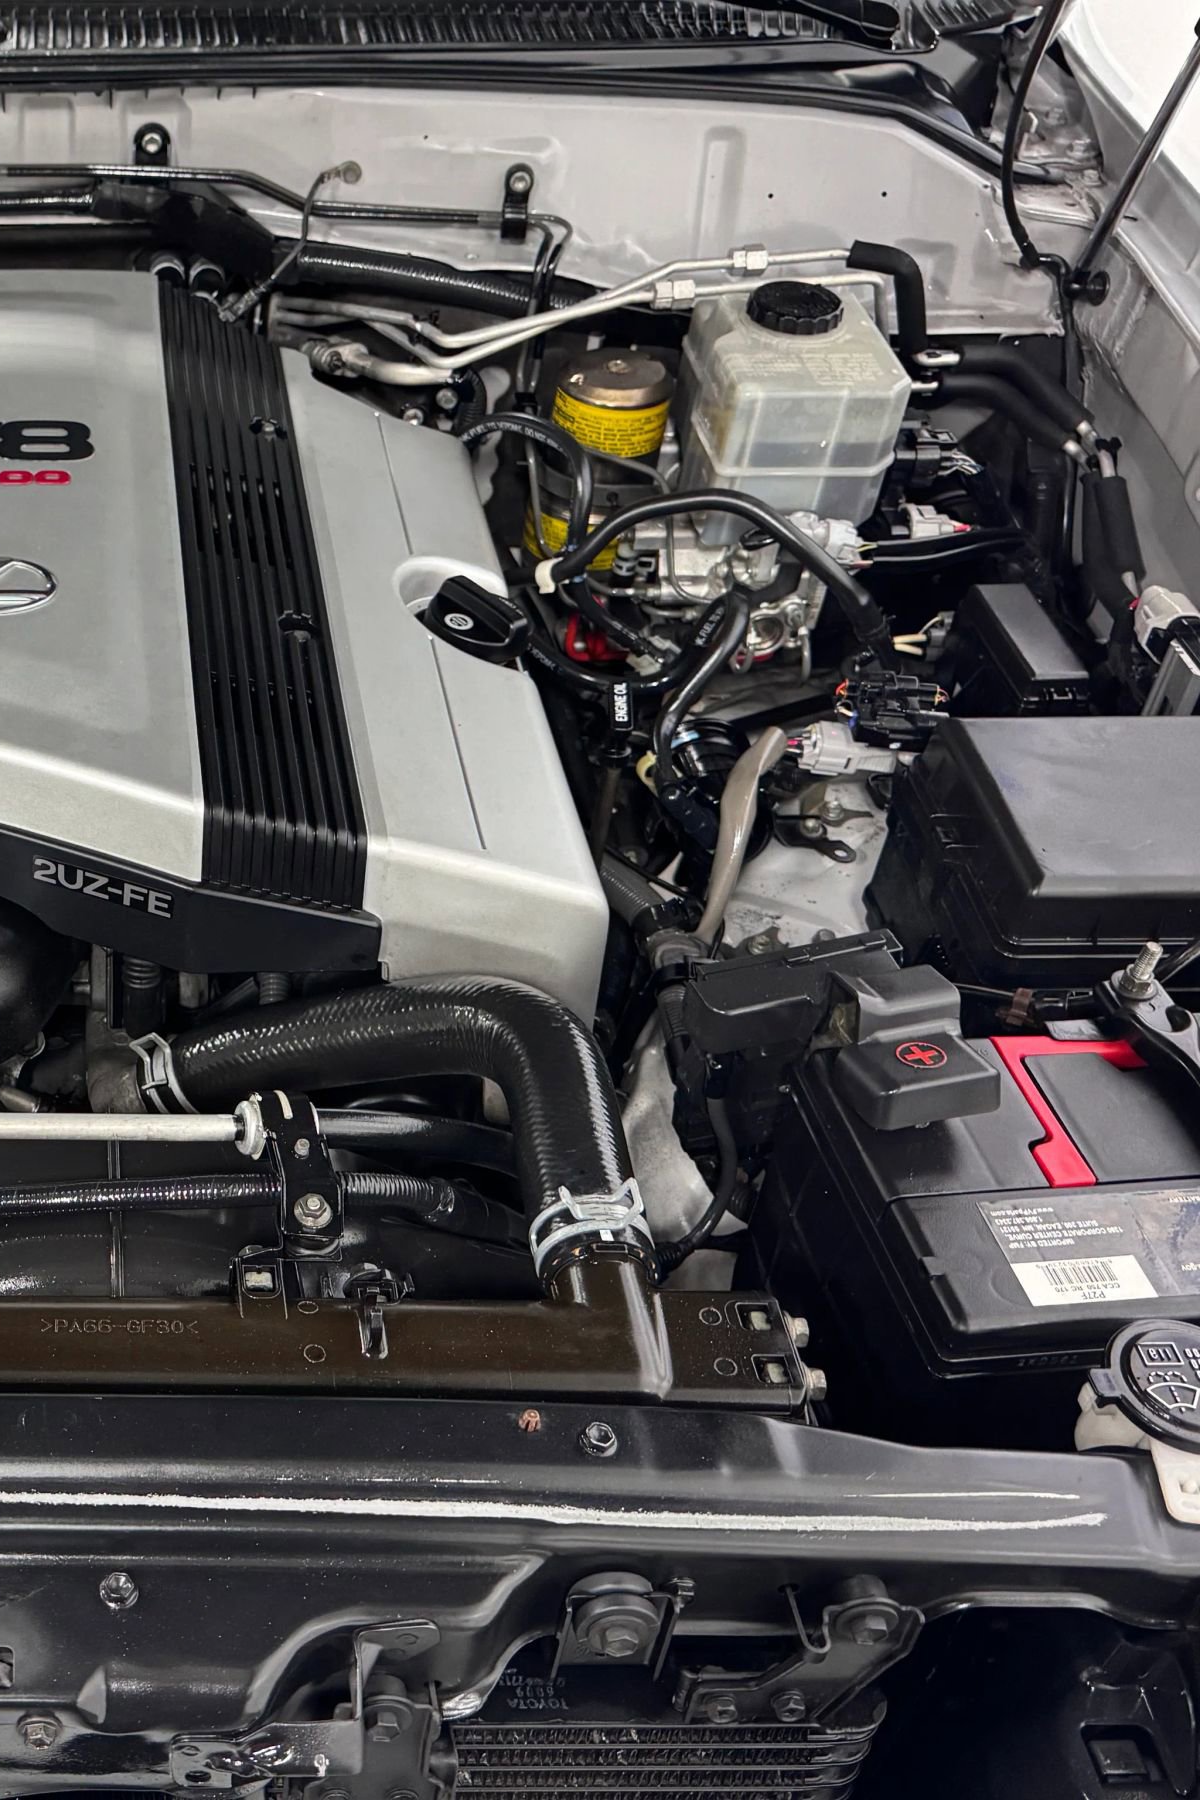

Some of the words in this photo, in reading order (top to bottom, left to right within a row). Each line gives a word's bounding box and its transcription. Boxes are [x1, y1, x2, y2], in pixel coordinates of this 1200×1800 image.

[617, 682, 629, 695] OIL
[615, 695, 629, 722] ENGINE
[33, 856, 173, 919] 2UZ-FE
[1033, 1230, 1062, 1239] CENTER
[1063, 1227, 1106, 1237] CORPORATE
[1038, 1238, 1075, 1247] IMPORTED
[1087, 1283, 1102, 1291] 750
[1102, 1281, 1120, 1290] CCA
[1081, 1292, 1106, 1301] P27F
[506, 1697, 569, 1710] TOYOTA
